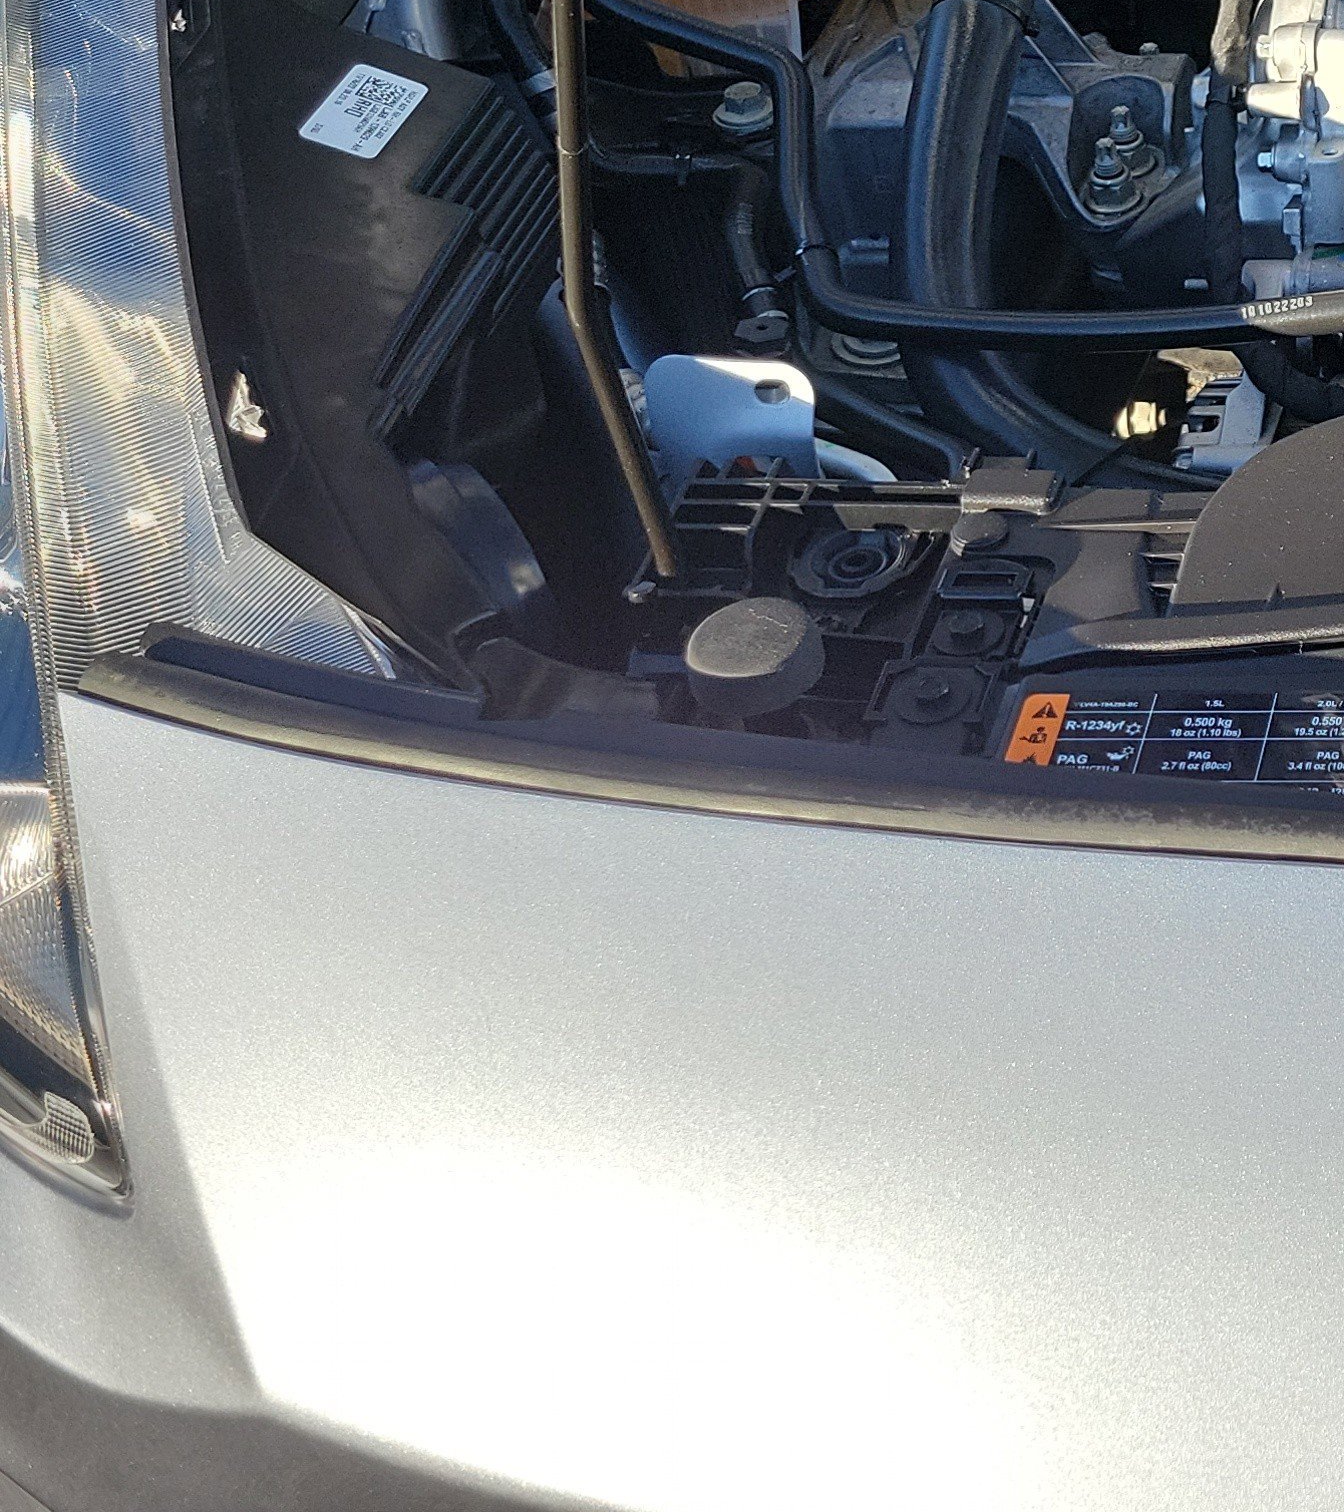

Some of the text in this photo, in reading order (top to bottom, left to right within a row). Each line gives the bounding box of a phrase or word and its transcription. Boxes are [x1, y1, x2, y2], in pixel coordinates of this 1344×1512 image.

[1204, 700, 1226, 708] 1.5L
[1317, 699, 1338, 708] 2.0L
[1064, 719, 1124, 733] R-1234yf
[1183, 717, 1233, 729] 0.500 kg
[1311, 716, 1343, 726] 0.550
[1169, 729, 1182, 737] 18
[1197, 728, 1218, 738] (1.10
[1219, 728, 1242, 739] lbs)
[1294, 727, 1314, 736] 19.5
[1056, 754, 1089, 765] PAG
[1187, 751, 1212, 760] PAG
[1316, 751, 1340, 760] PAG
[1161, 761, 1178, 771] 2.7
[1287, 761, 1304, 771] 3.4
[1313, 763, 1326, 771] oz
